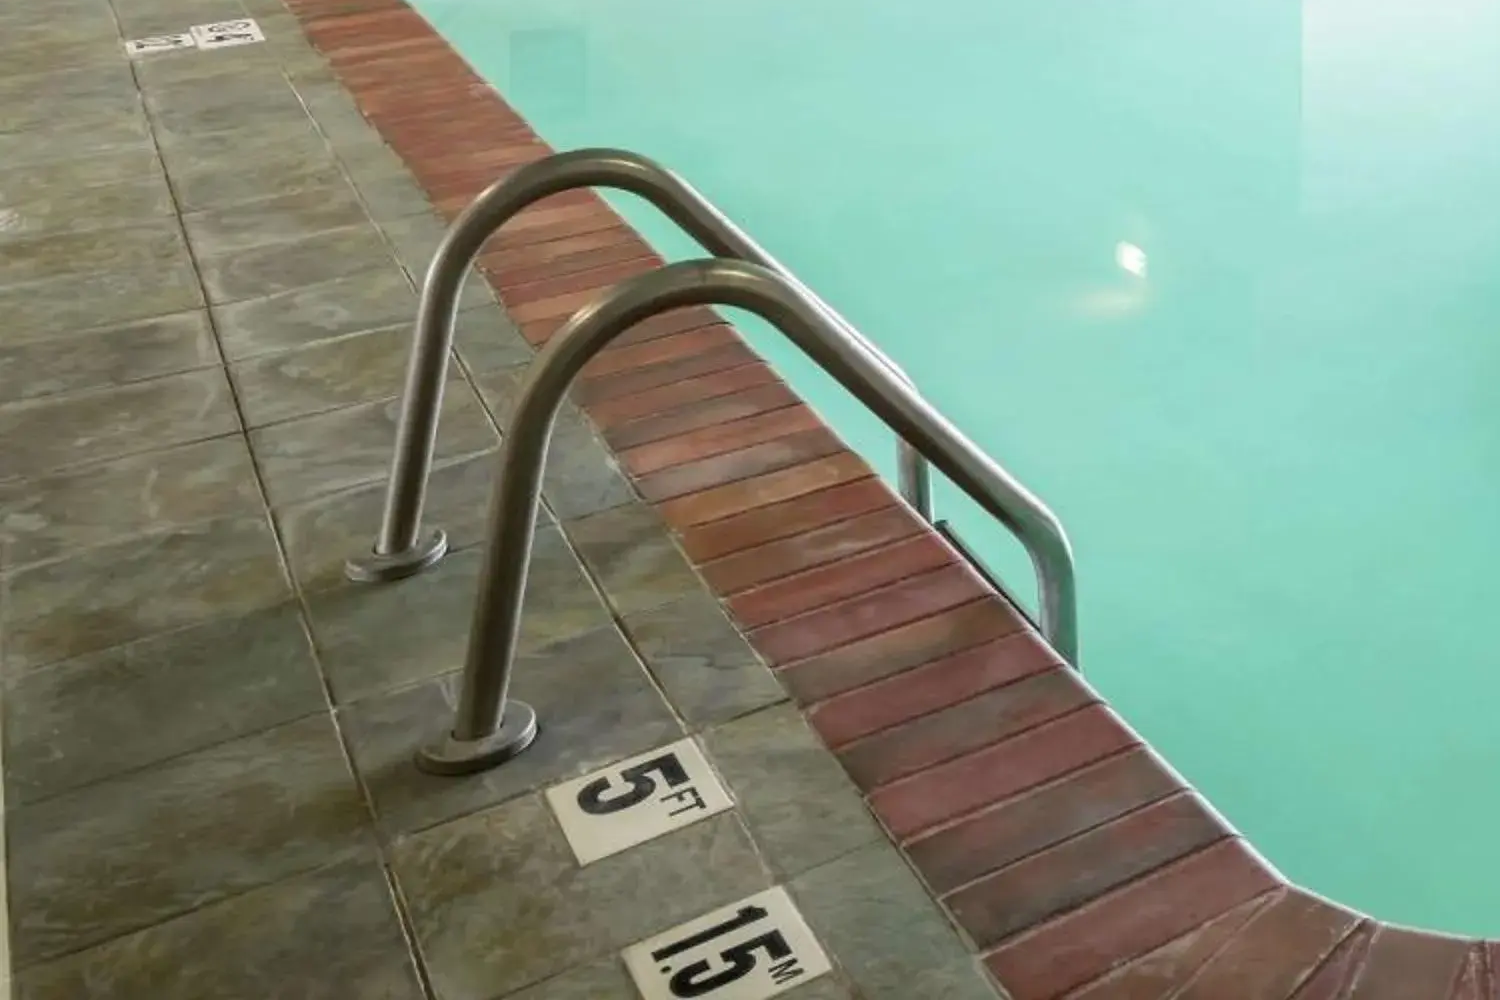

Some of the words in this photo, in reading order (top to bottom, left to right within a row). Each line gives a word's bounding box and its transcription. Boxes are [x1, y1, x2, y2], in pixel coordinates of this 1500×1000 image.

[576, 752, 691, 815] 5
[659, 786, 707, 818] FT
[767, 956, 806, 986] M
